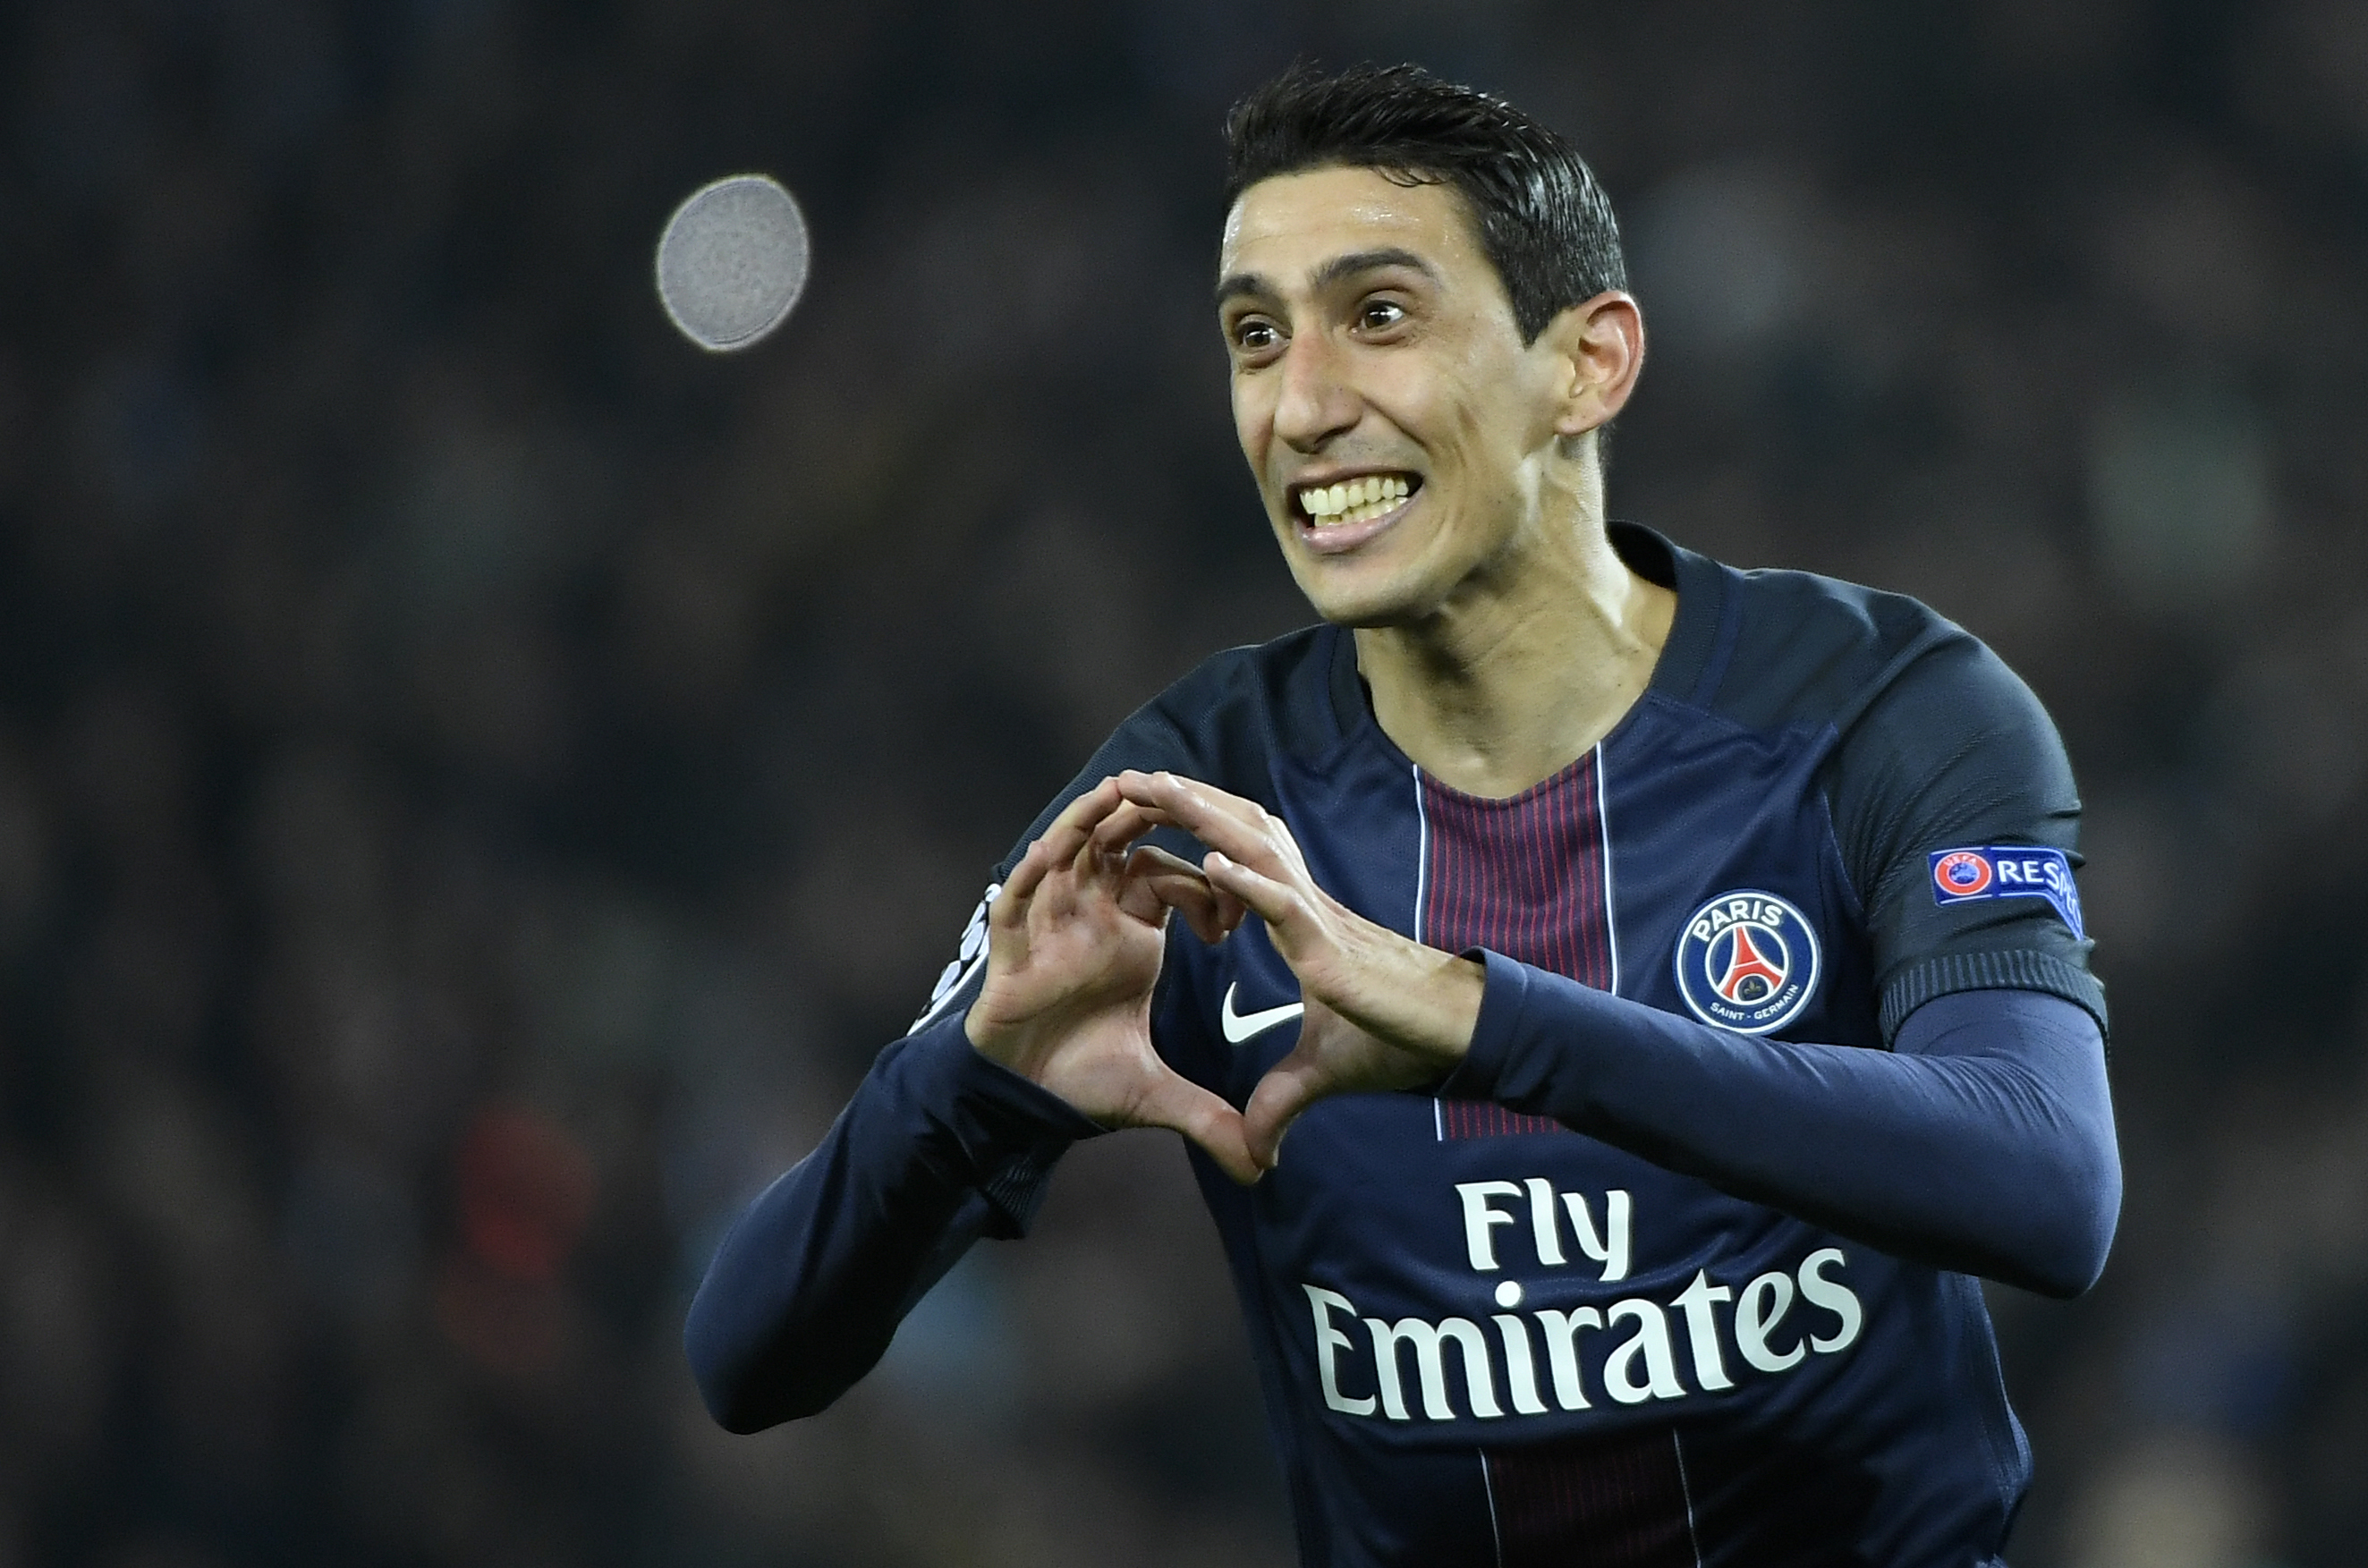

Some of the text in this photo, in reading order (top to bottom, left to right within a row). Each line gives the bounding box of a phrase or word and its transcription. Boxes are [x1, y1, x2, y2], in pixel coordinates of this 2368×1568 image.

[1942, 855, 1977, 867] UEFA
[1693, 900, 1783, 942] PARIS
[1455, 1178, 1629, 1281] Fly
[1302, 1249, 1862, 1420] Emirates
